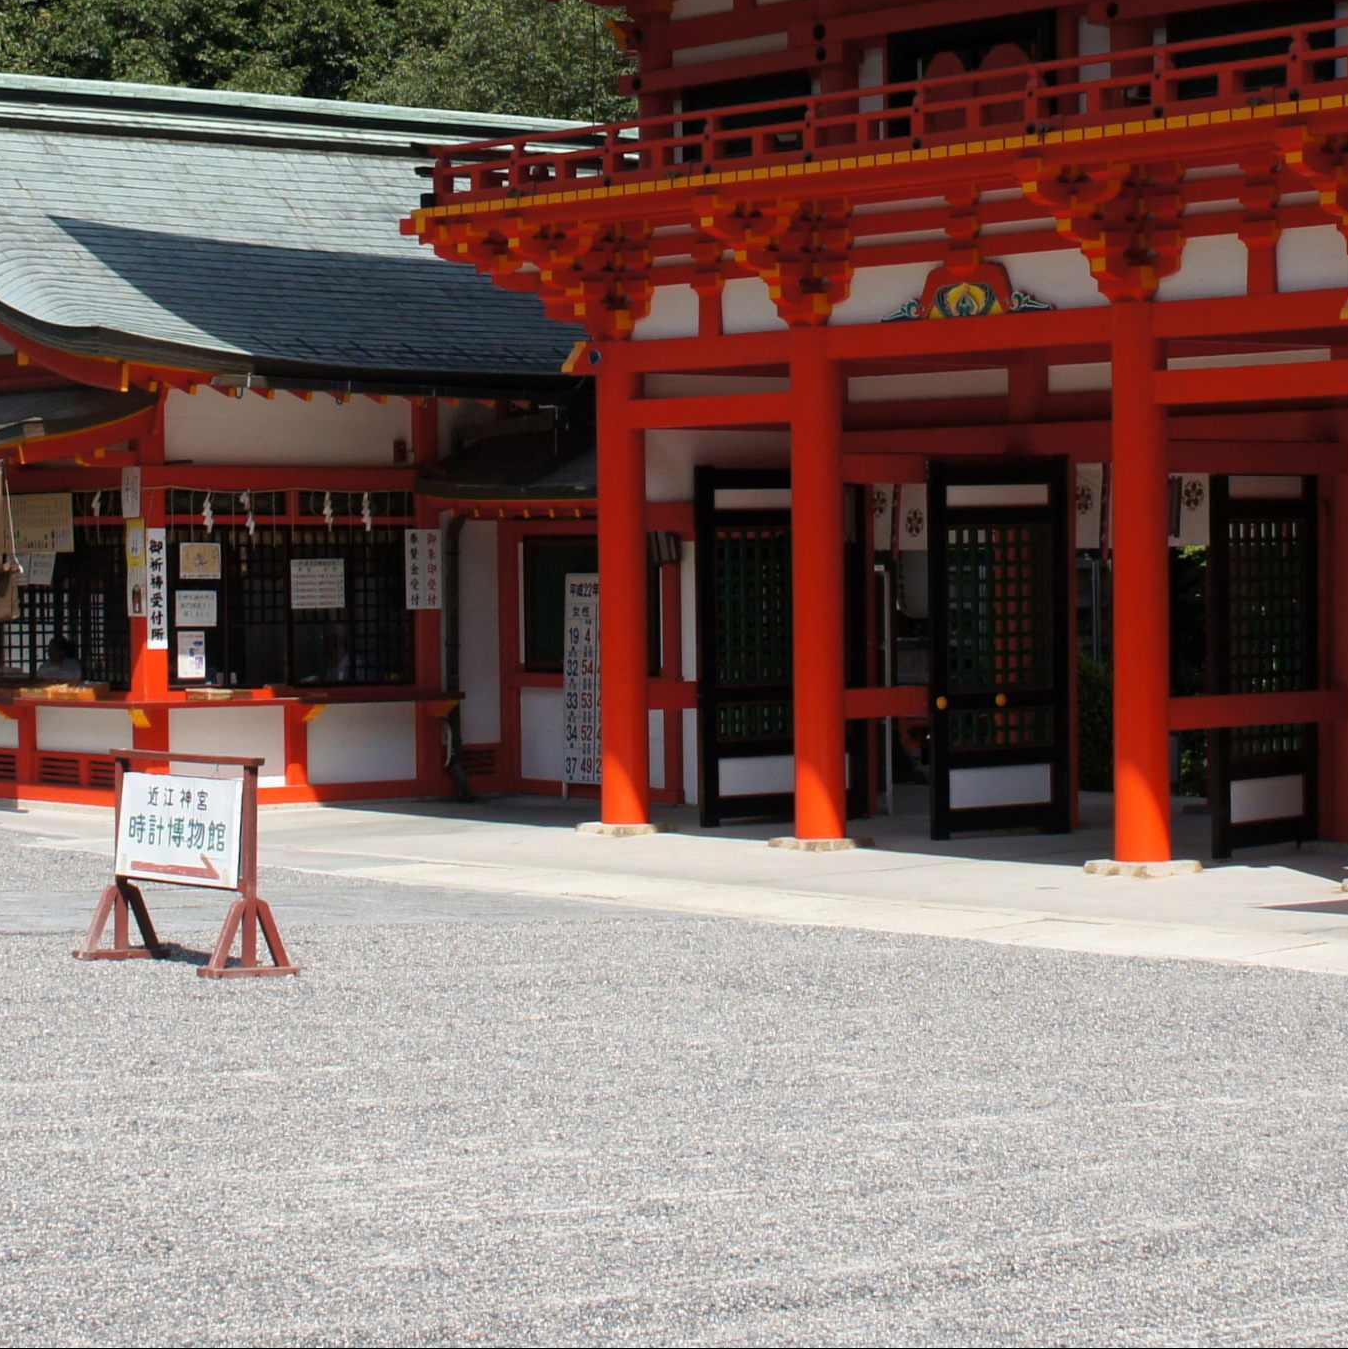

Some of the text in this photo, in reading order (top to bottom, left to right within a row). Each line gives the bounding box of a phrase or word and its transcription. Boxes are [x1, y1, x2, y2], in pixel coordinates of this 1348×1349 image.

[569, 627, 580, 645] 19
[584, 627, 591, 643] 4
[566, 659, 579, 677] 32
[581, 658, 594, 676] 54
[566, 692, 578, 710] 33
[581, 691, 593, 709] 53
[566, 724, 578, 741] 34
[581, 725, 592, 741] 52
[565, 756, 578, 774] 37
[580, 756, 593, 774] 49
[147, 785, 209, 812] 近江神宮
[128, 813, 227, 852] 時計博物館
